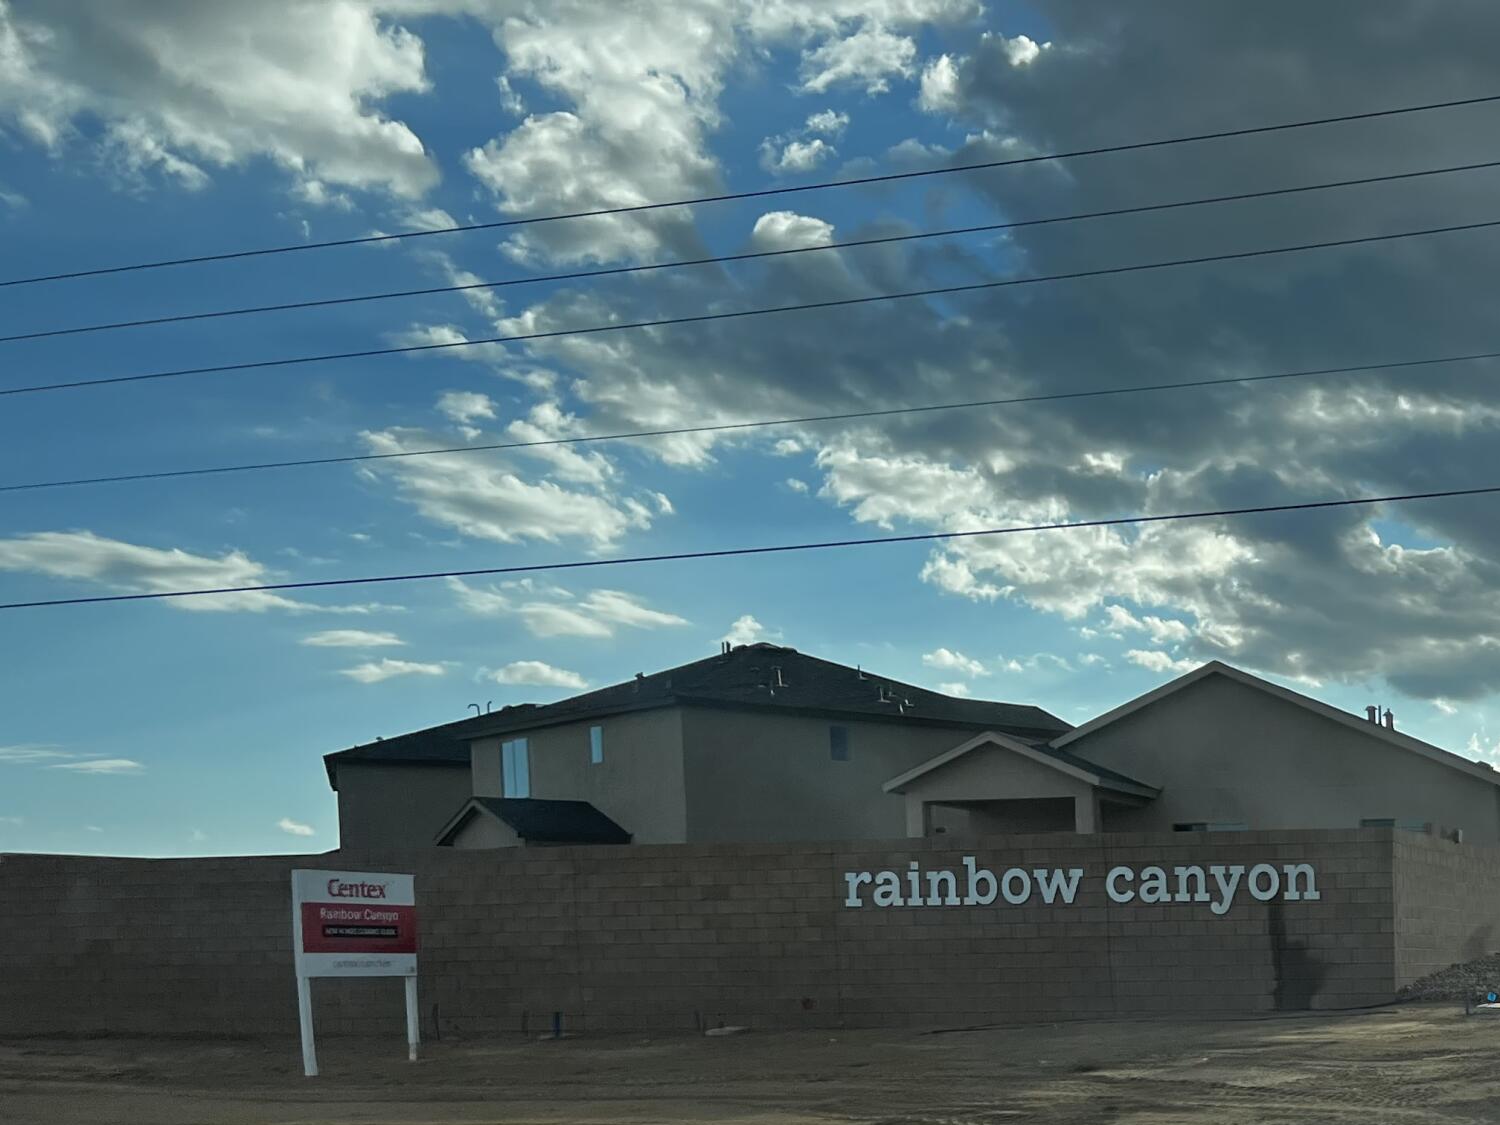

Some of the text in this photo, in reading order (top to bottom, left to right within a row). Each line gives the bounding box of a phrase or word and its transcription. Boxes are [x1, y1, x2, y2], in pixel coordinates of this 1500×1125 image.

[327, 879, 387, 899] Centex
[845, 856, 1321, 915] rainbow canyon
[320, 907, 361, 921] Rainbow
